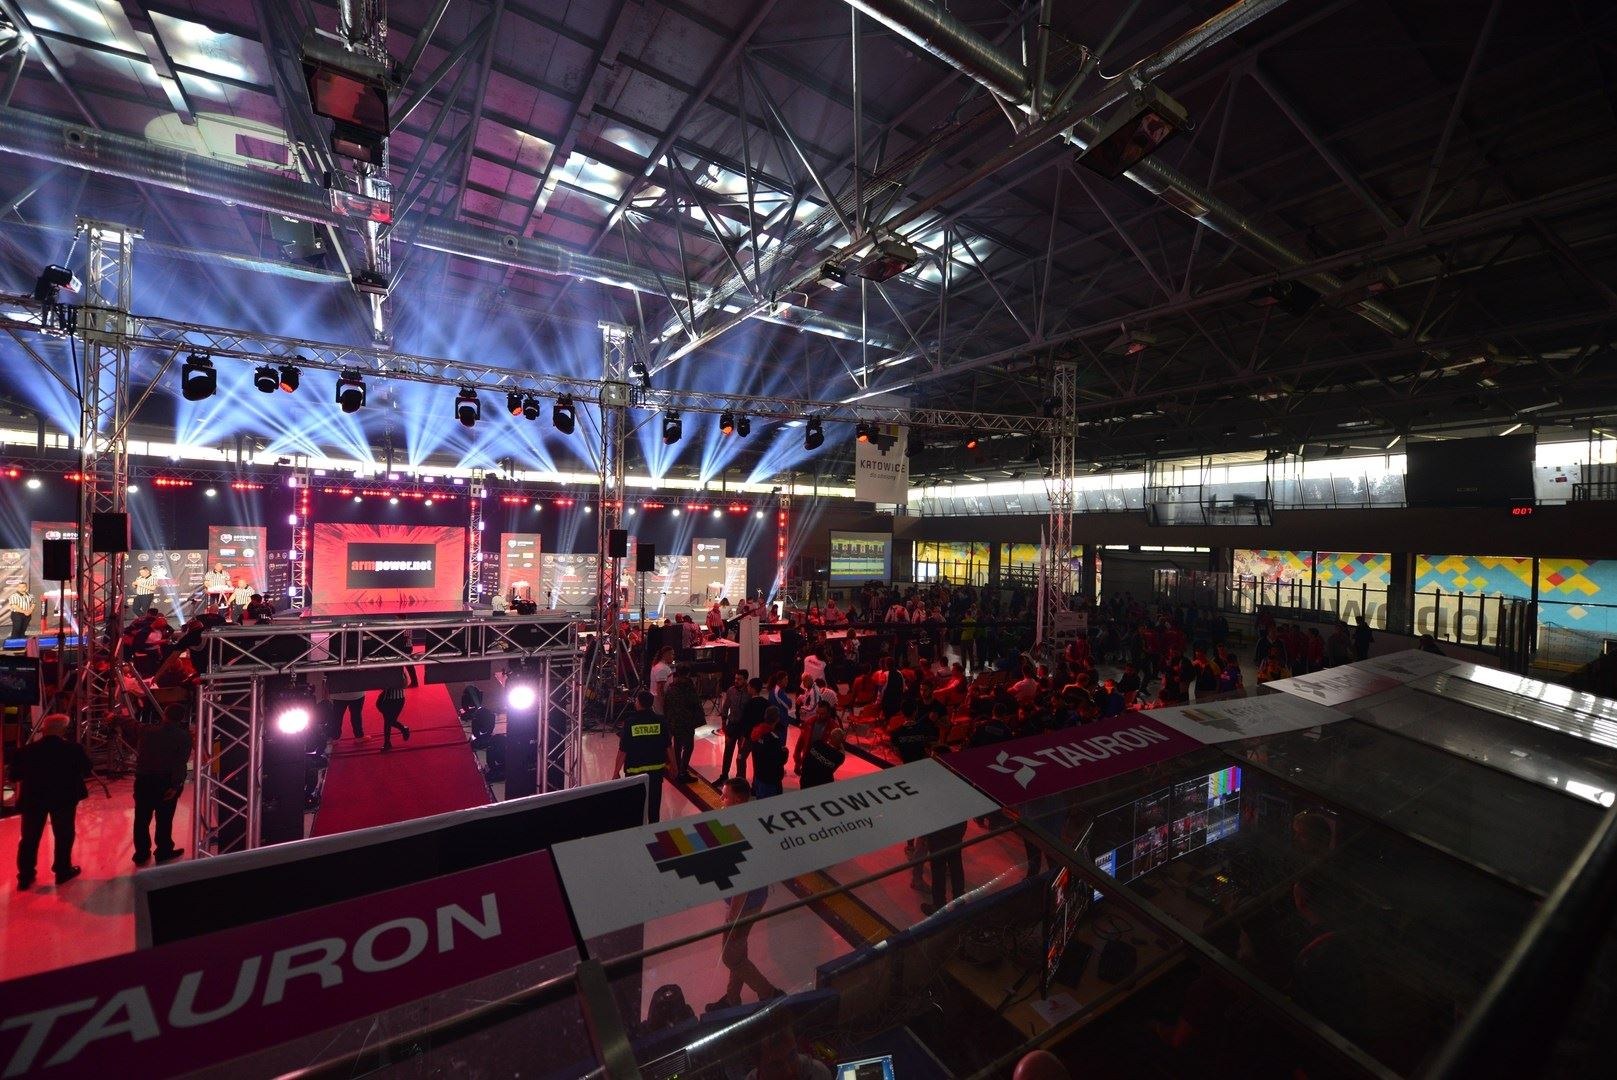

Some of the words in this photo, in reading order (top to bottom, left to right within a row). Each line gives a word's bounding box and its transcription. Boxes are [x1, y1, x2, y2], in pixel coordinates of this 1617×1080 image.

[860, 459, 906, 473] KATOWICE
[351, 560, 432, 572] armpower.net
[1033, 724, 1171, 770] TAURON
[757, 780, 919, 834] KATOWICE
[780, 833, 806, 851] dla
[808, 815, 874, 842] odmiany
[0, 892, 502, 1079] TAURON
